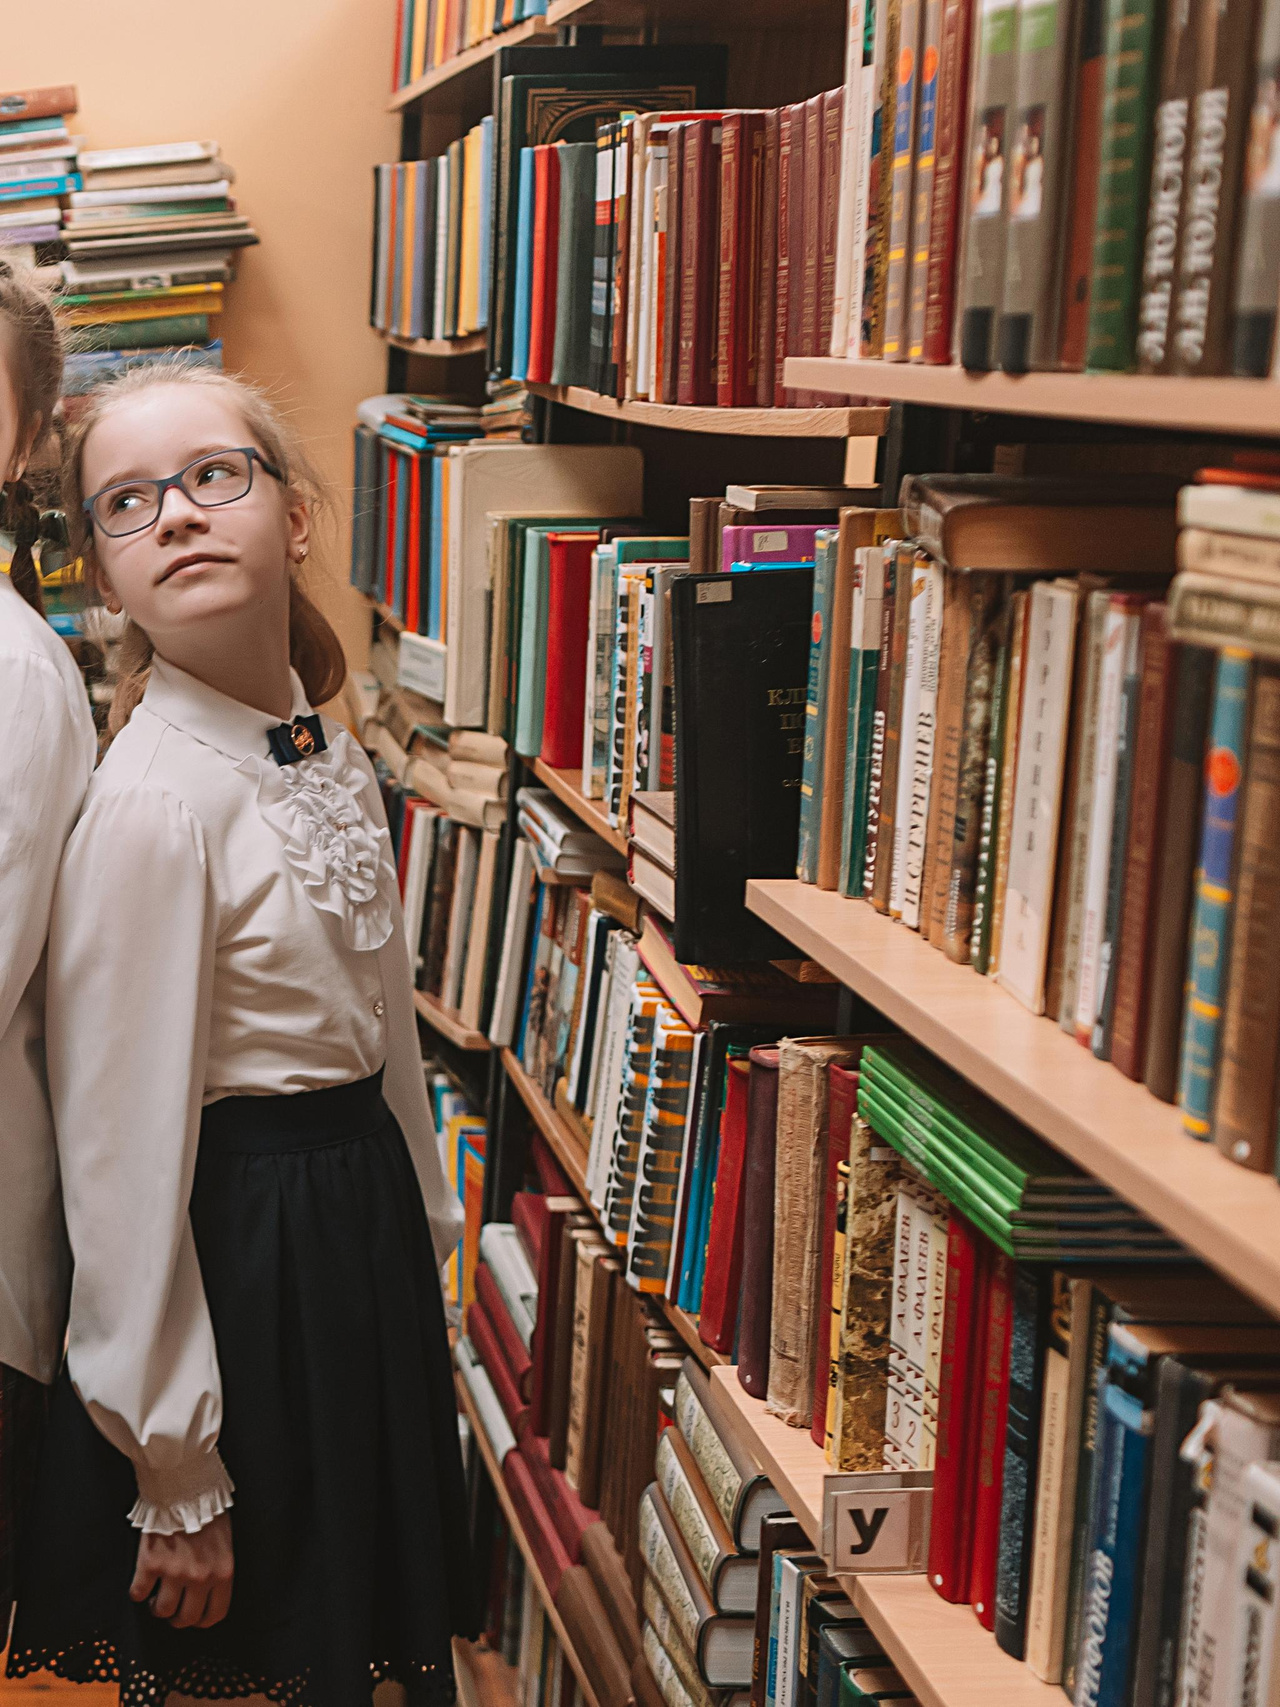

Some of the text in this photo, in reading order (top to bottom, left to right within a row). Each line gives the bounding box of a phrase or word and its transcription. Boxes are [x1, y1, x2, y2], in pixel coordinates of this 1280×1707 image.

[854, 198, 863, 245] КАЗАКИ
[1142, 98, 1188, 277] ТОЛСТОЙ
[1181, 87, 1230, 273] ТОЛСТОЙ
[867, 710, 886, 834] ТУРГЕНЕВ
[908, 711, 933, 851] ТУРГЕНЕВ
[629, 1046, 694, 1279] РУССКАЯ
[896, 1214, 911, 1302] ФАДЕЕВ
[913, 1230, 929, 1320] ФАДЕЕВ
[930, 1250, 945, 1340] ФАДЕЕВ
[891, 1401, 901, 1428] 3
[905, 1421, 917, 1448] 2
[924, 1444, 930, 1468] 1
[848, 1507, 890, 1555] У
